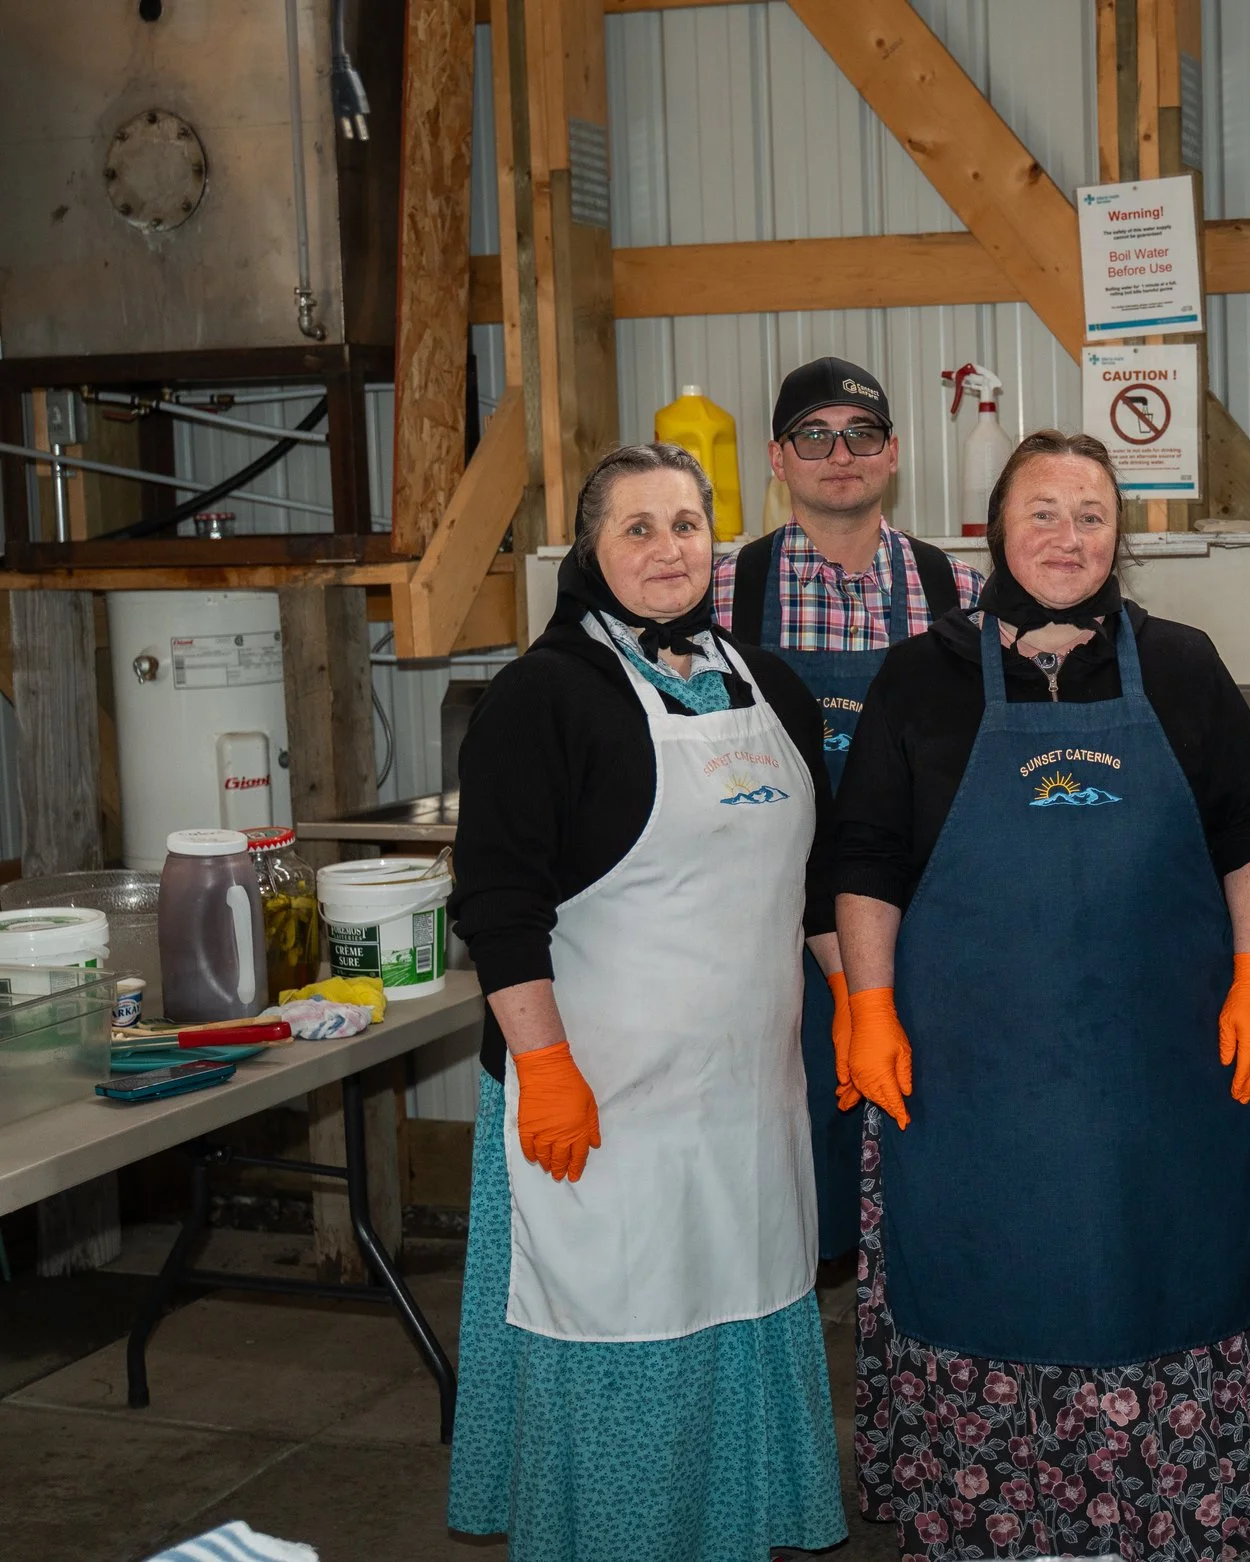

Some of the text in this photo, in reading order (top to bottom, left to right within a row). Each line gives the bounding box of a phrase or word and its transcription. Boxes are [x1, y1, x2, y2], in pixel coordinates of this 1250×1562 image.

[1108, 206, 1164, 221] Warning!
[1109, 248, 1169, 262] Boil Water
[1108, 262, 1173, 278] Before Use
[1102, 370, 1168, 381] CAUTION
[1020, 749, 1121, 777] SUNSET CATERING
[335, 944, 364, 957] CRÈME
[339, 956, 360, 967] SURE
